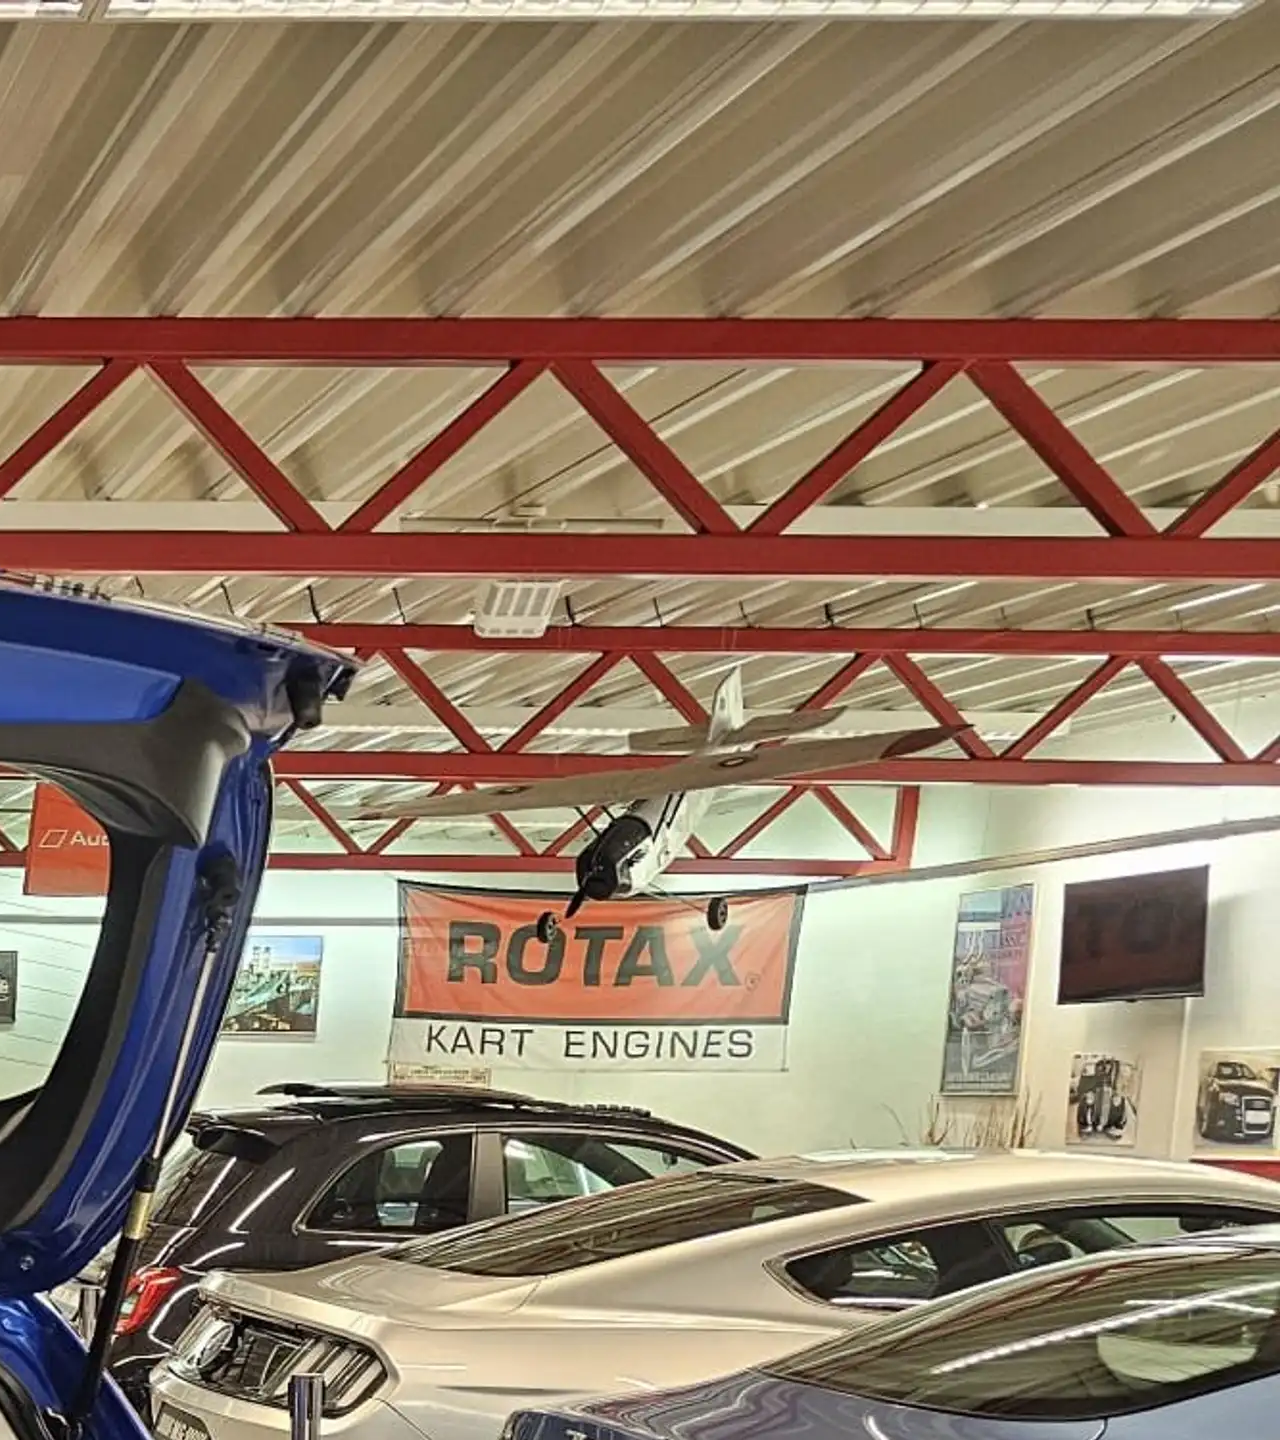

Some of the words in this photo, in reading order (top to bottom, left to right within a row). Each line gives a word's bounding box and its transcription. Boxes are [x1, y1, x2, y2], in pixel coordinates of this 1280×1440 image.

[447, 920, 741, 987] ROTAX
[426, 1025, 534, 1056] KART
[564, 1030, 754, 1060] ENGINES
